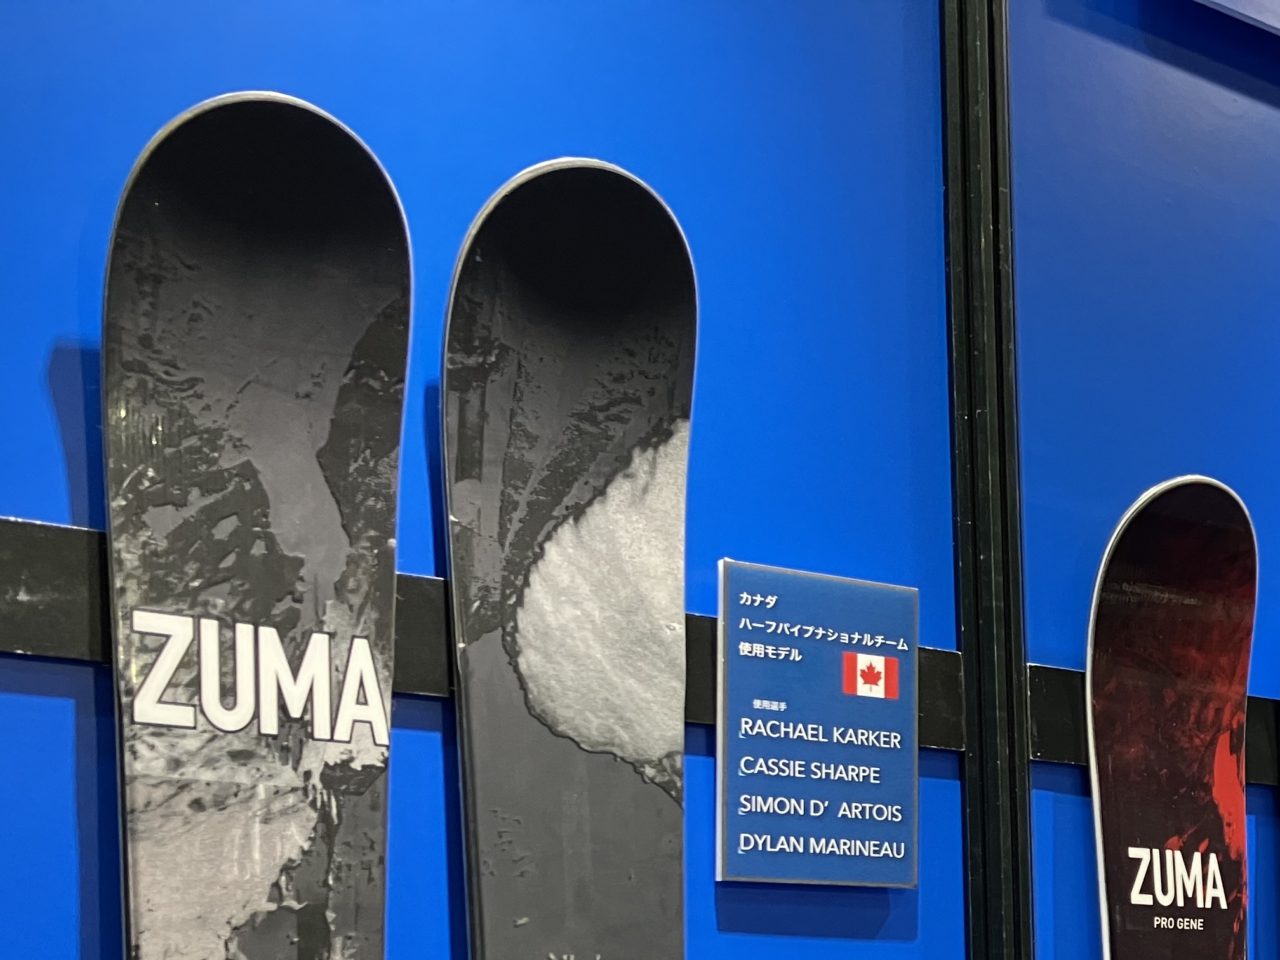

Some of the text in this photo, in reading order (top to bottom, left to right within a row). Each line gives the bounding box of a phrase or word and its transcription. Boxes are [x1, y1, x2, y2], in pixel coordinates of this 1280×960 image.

[739, 592, 777, 609] カナダ
[739, 617, 908, 651] ハーフパイプナショナルチーム
[738, 642, 802, 662] 使用モデル
[132, 610, 389, 746] ZUMA
[753, 699, 787, 712] 使用選手
[740, 718, 901, 749] RACHAEL KARKER
[740, 756, 880, 783] CASSIE SHARPE
[740, 795, 804, 815] SIMON
[838, 802, 902, 822] ARTOIS
[740, 833, 904, 859] DYLAN MARINEAU
[1128, 846, 1228, 909] ZUMA
[1154, 917, 1204, 930] PRO GENE
